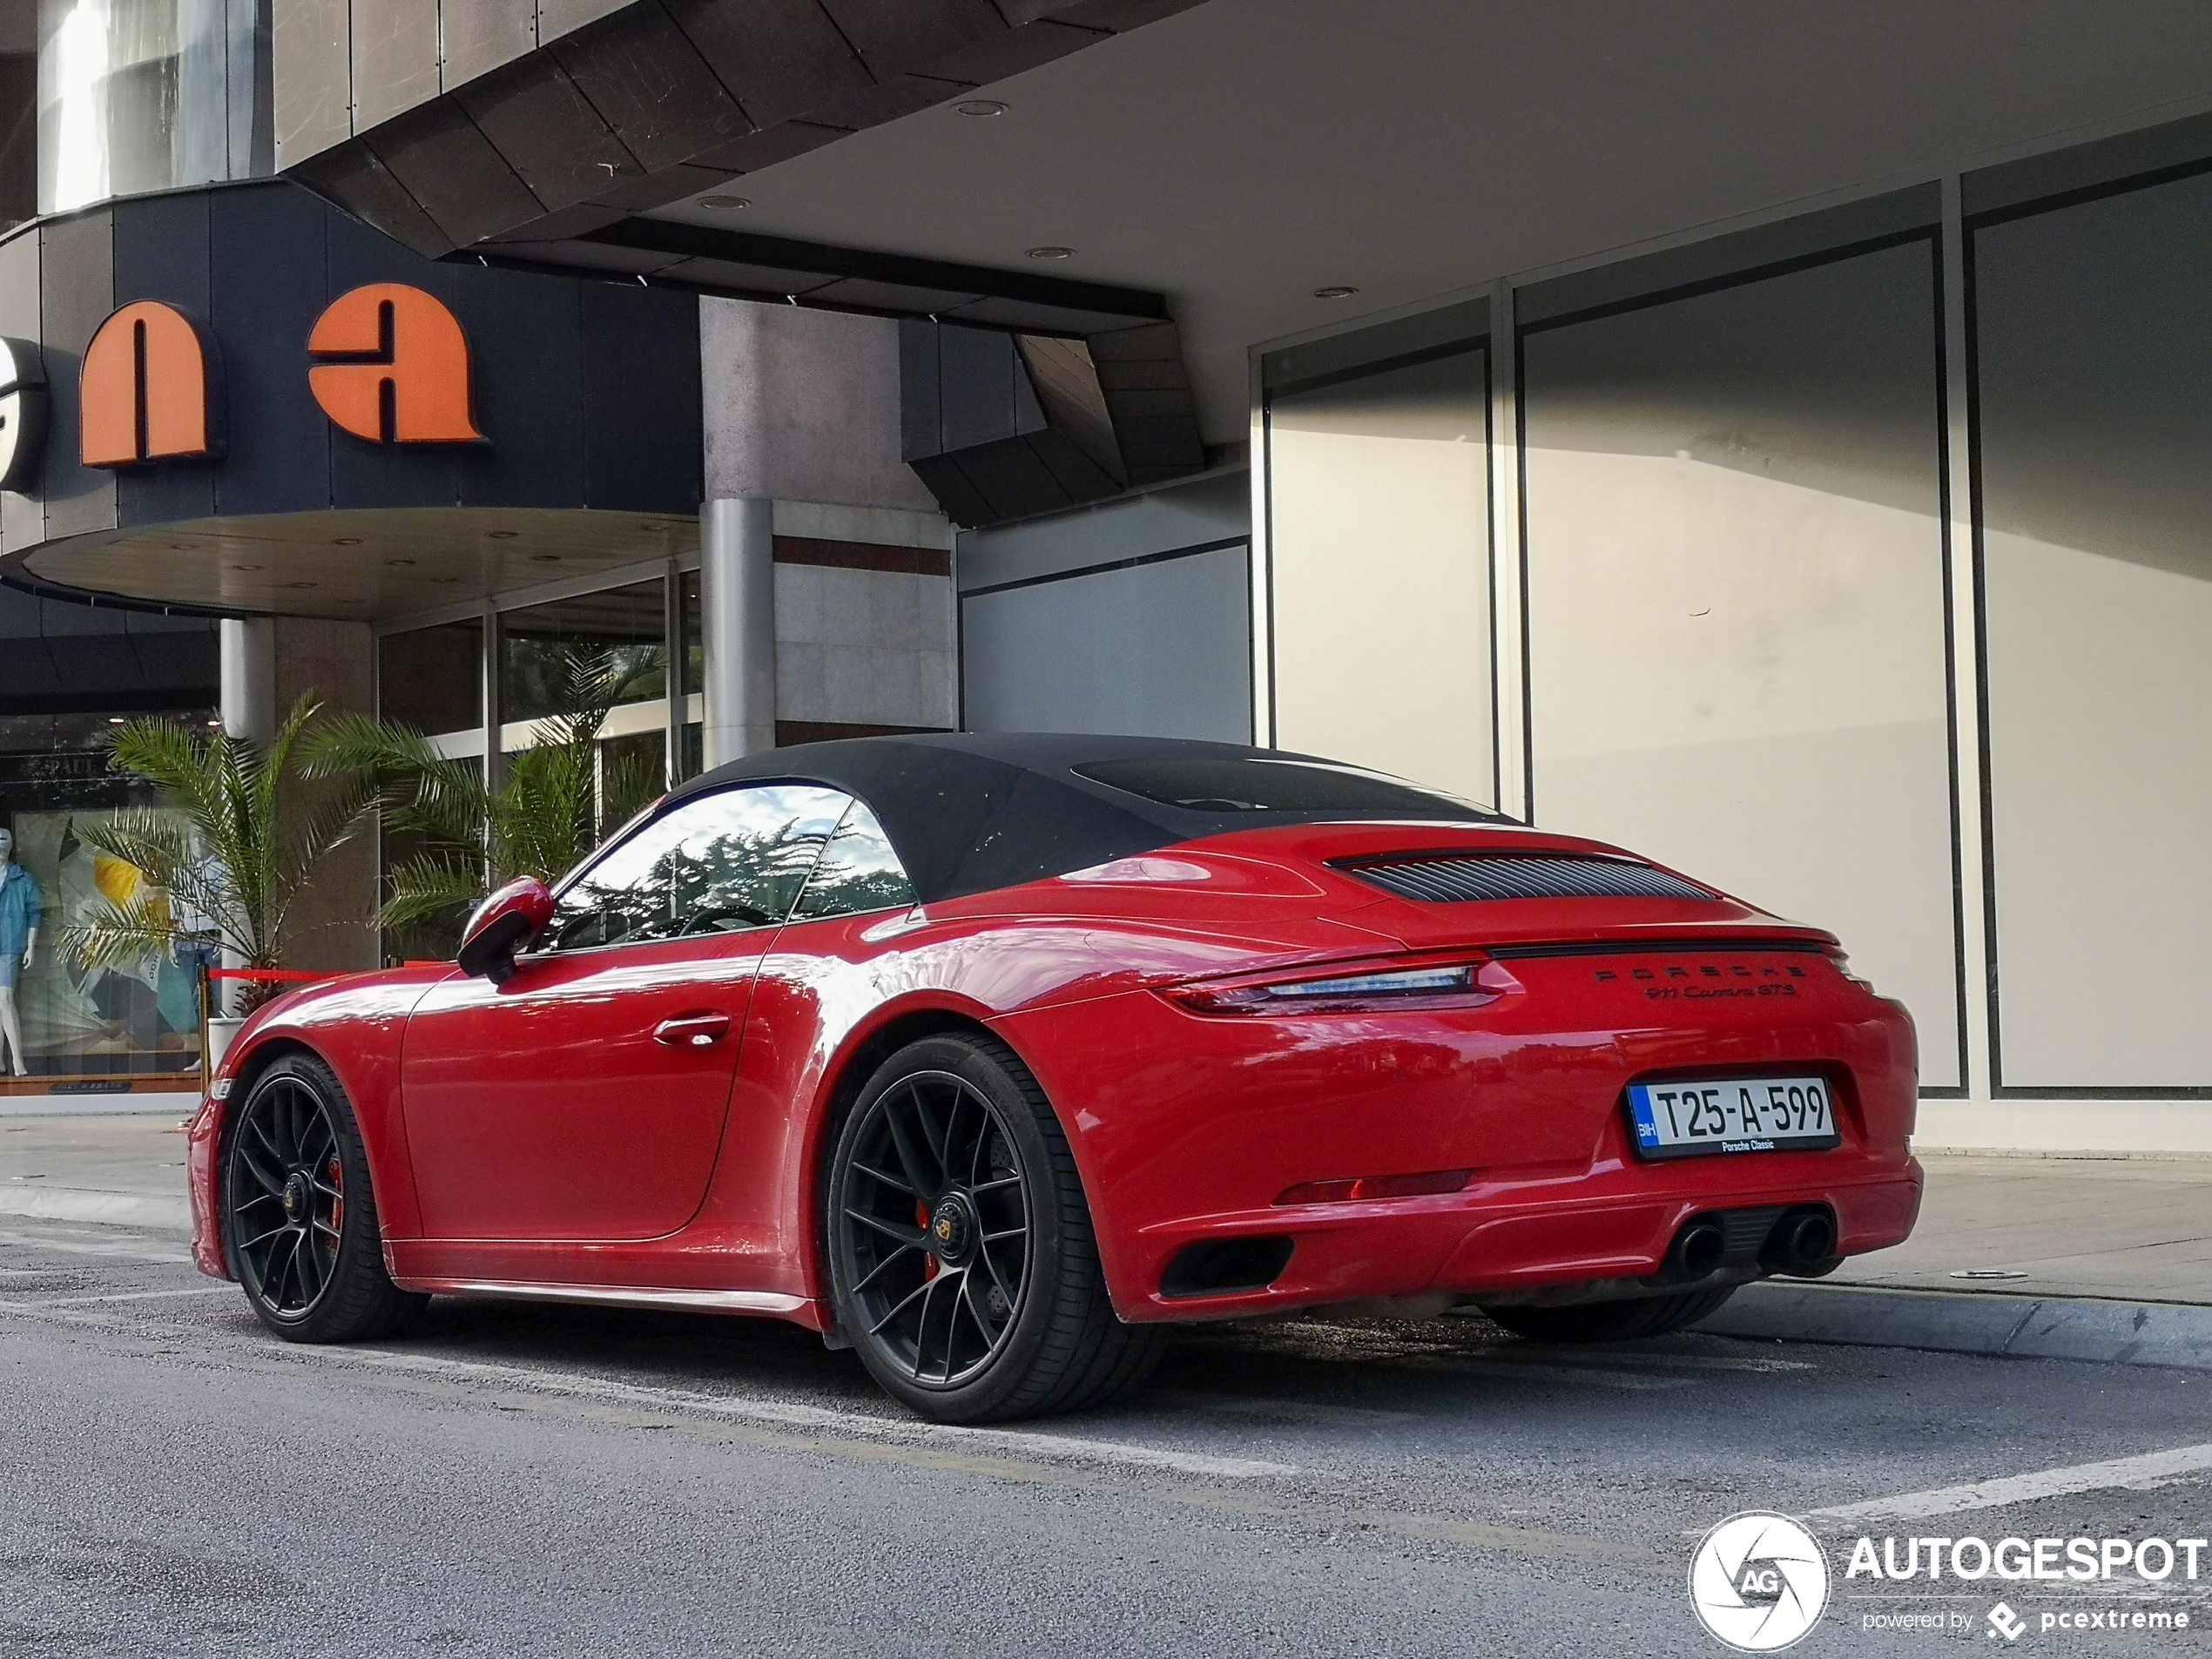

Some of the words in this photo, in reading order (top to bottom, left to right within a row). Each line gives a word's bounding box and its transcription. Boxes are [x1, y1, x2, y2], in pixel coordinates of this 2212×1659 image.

[1594, 965, 1806, 981] PORSCHE
[1645, 987, 1677, 999] 911
[1683, 985, 1756, 999] Carrera
[1757, 983, 1797, 996] GTS
[1657, 1086, 1824, 1138] T25-A-599
[1639, 1123, 1656, 1137] BIH
[1722, 1141, 1749, 1152] Porsche
[1751, 1139, 1774, 1150] Classic
